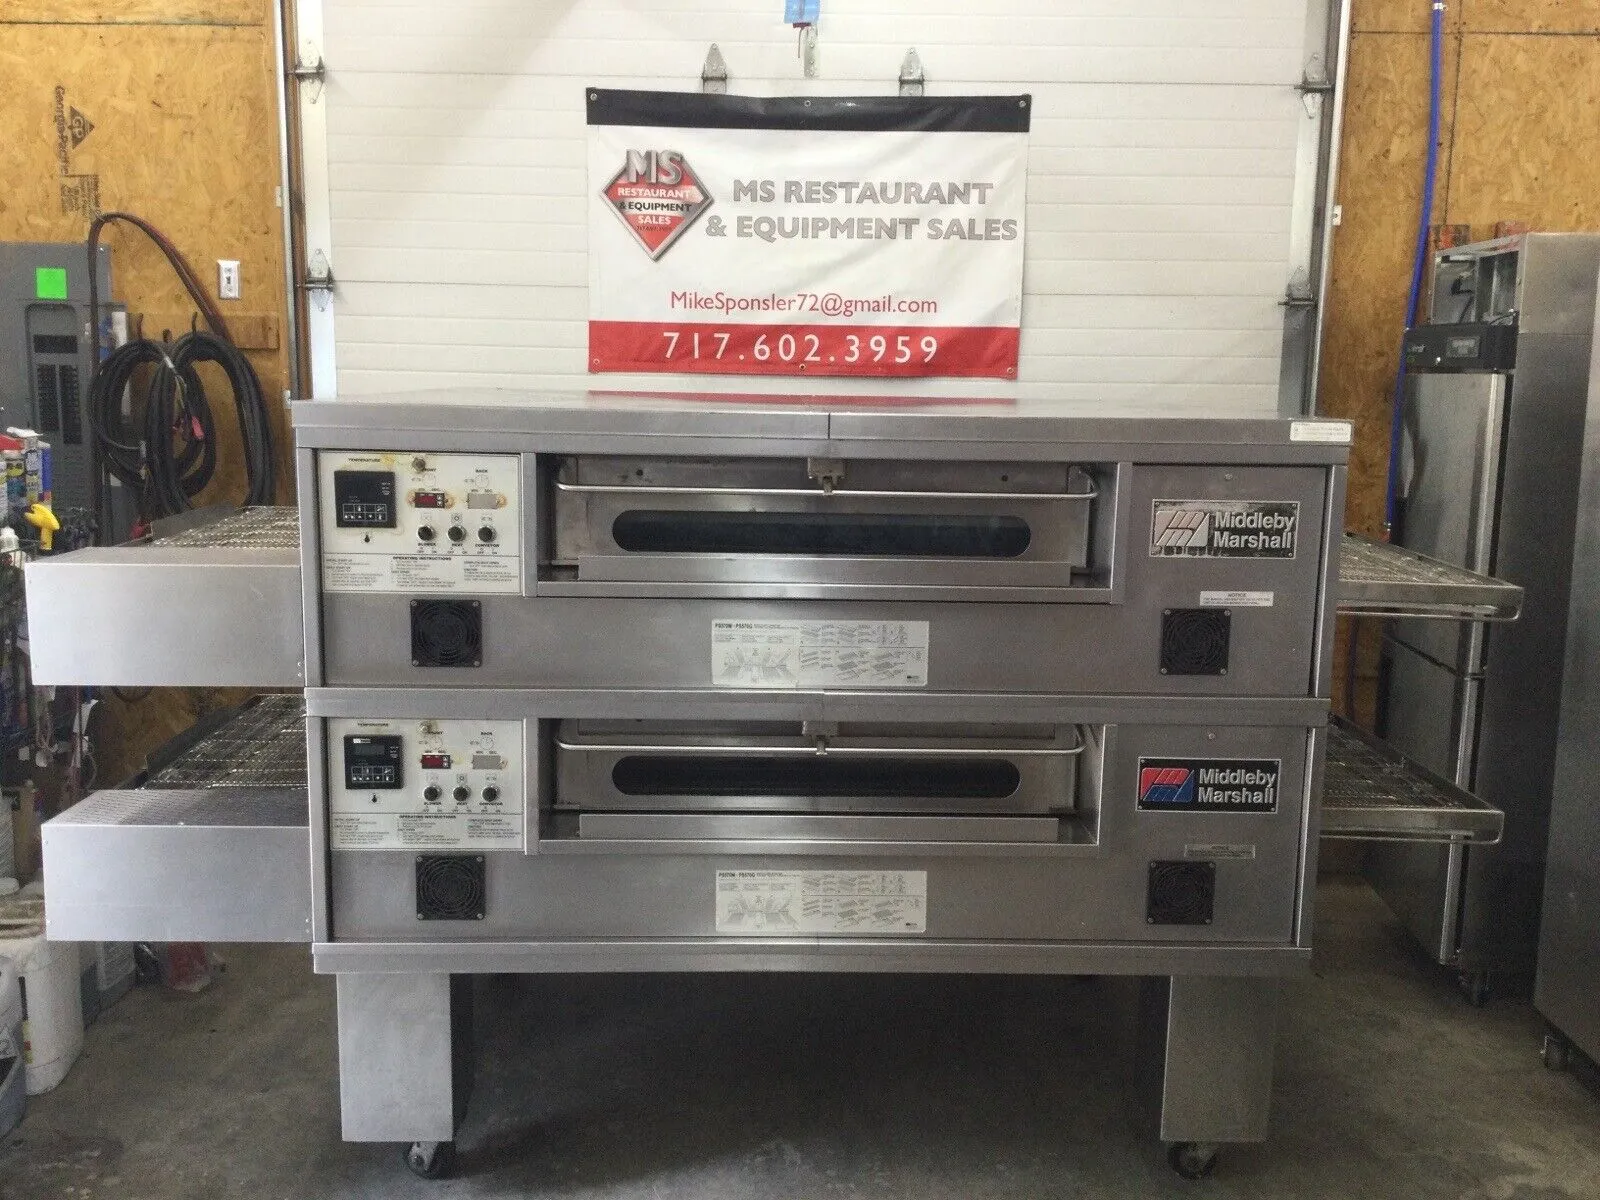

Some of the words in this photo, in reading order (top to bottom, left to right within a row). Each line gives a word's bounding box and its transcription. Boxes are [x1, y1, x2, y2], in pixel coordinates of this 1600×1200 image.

[625, 148, 683, 185] MS
[617, 187, 691, 200] RESTAURANT
[733, 180, 775, 204] MS
[784, 181, 993, 205] RESTAURANT
[618, 201, 628, 210] &
[628, 201, 692, 212] EQUIPMENT
[637, 215, 672, 225] SALES
[704, 215, 727, 238] &
[735, 215, 923, 243] EQUIPMENT
[926, 217, 1018, 242] SALES
[670, 290, 938, 317] MikeSponsler72@gmail.com
[662, 331, 939, 364] 717.602.3959
[1215, 511, 1296, 532] Middleby
[1213, 531, 1292, 550] Marshall
[1198, 768, 1277, 788] Middleby
[1198, 787, 1274, 804] Marshall
